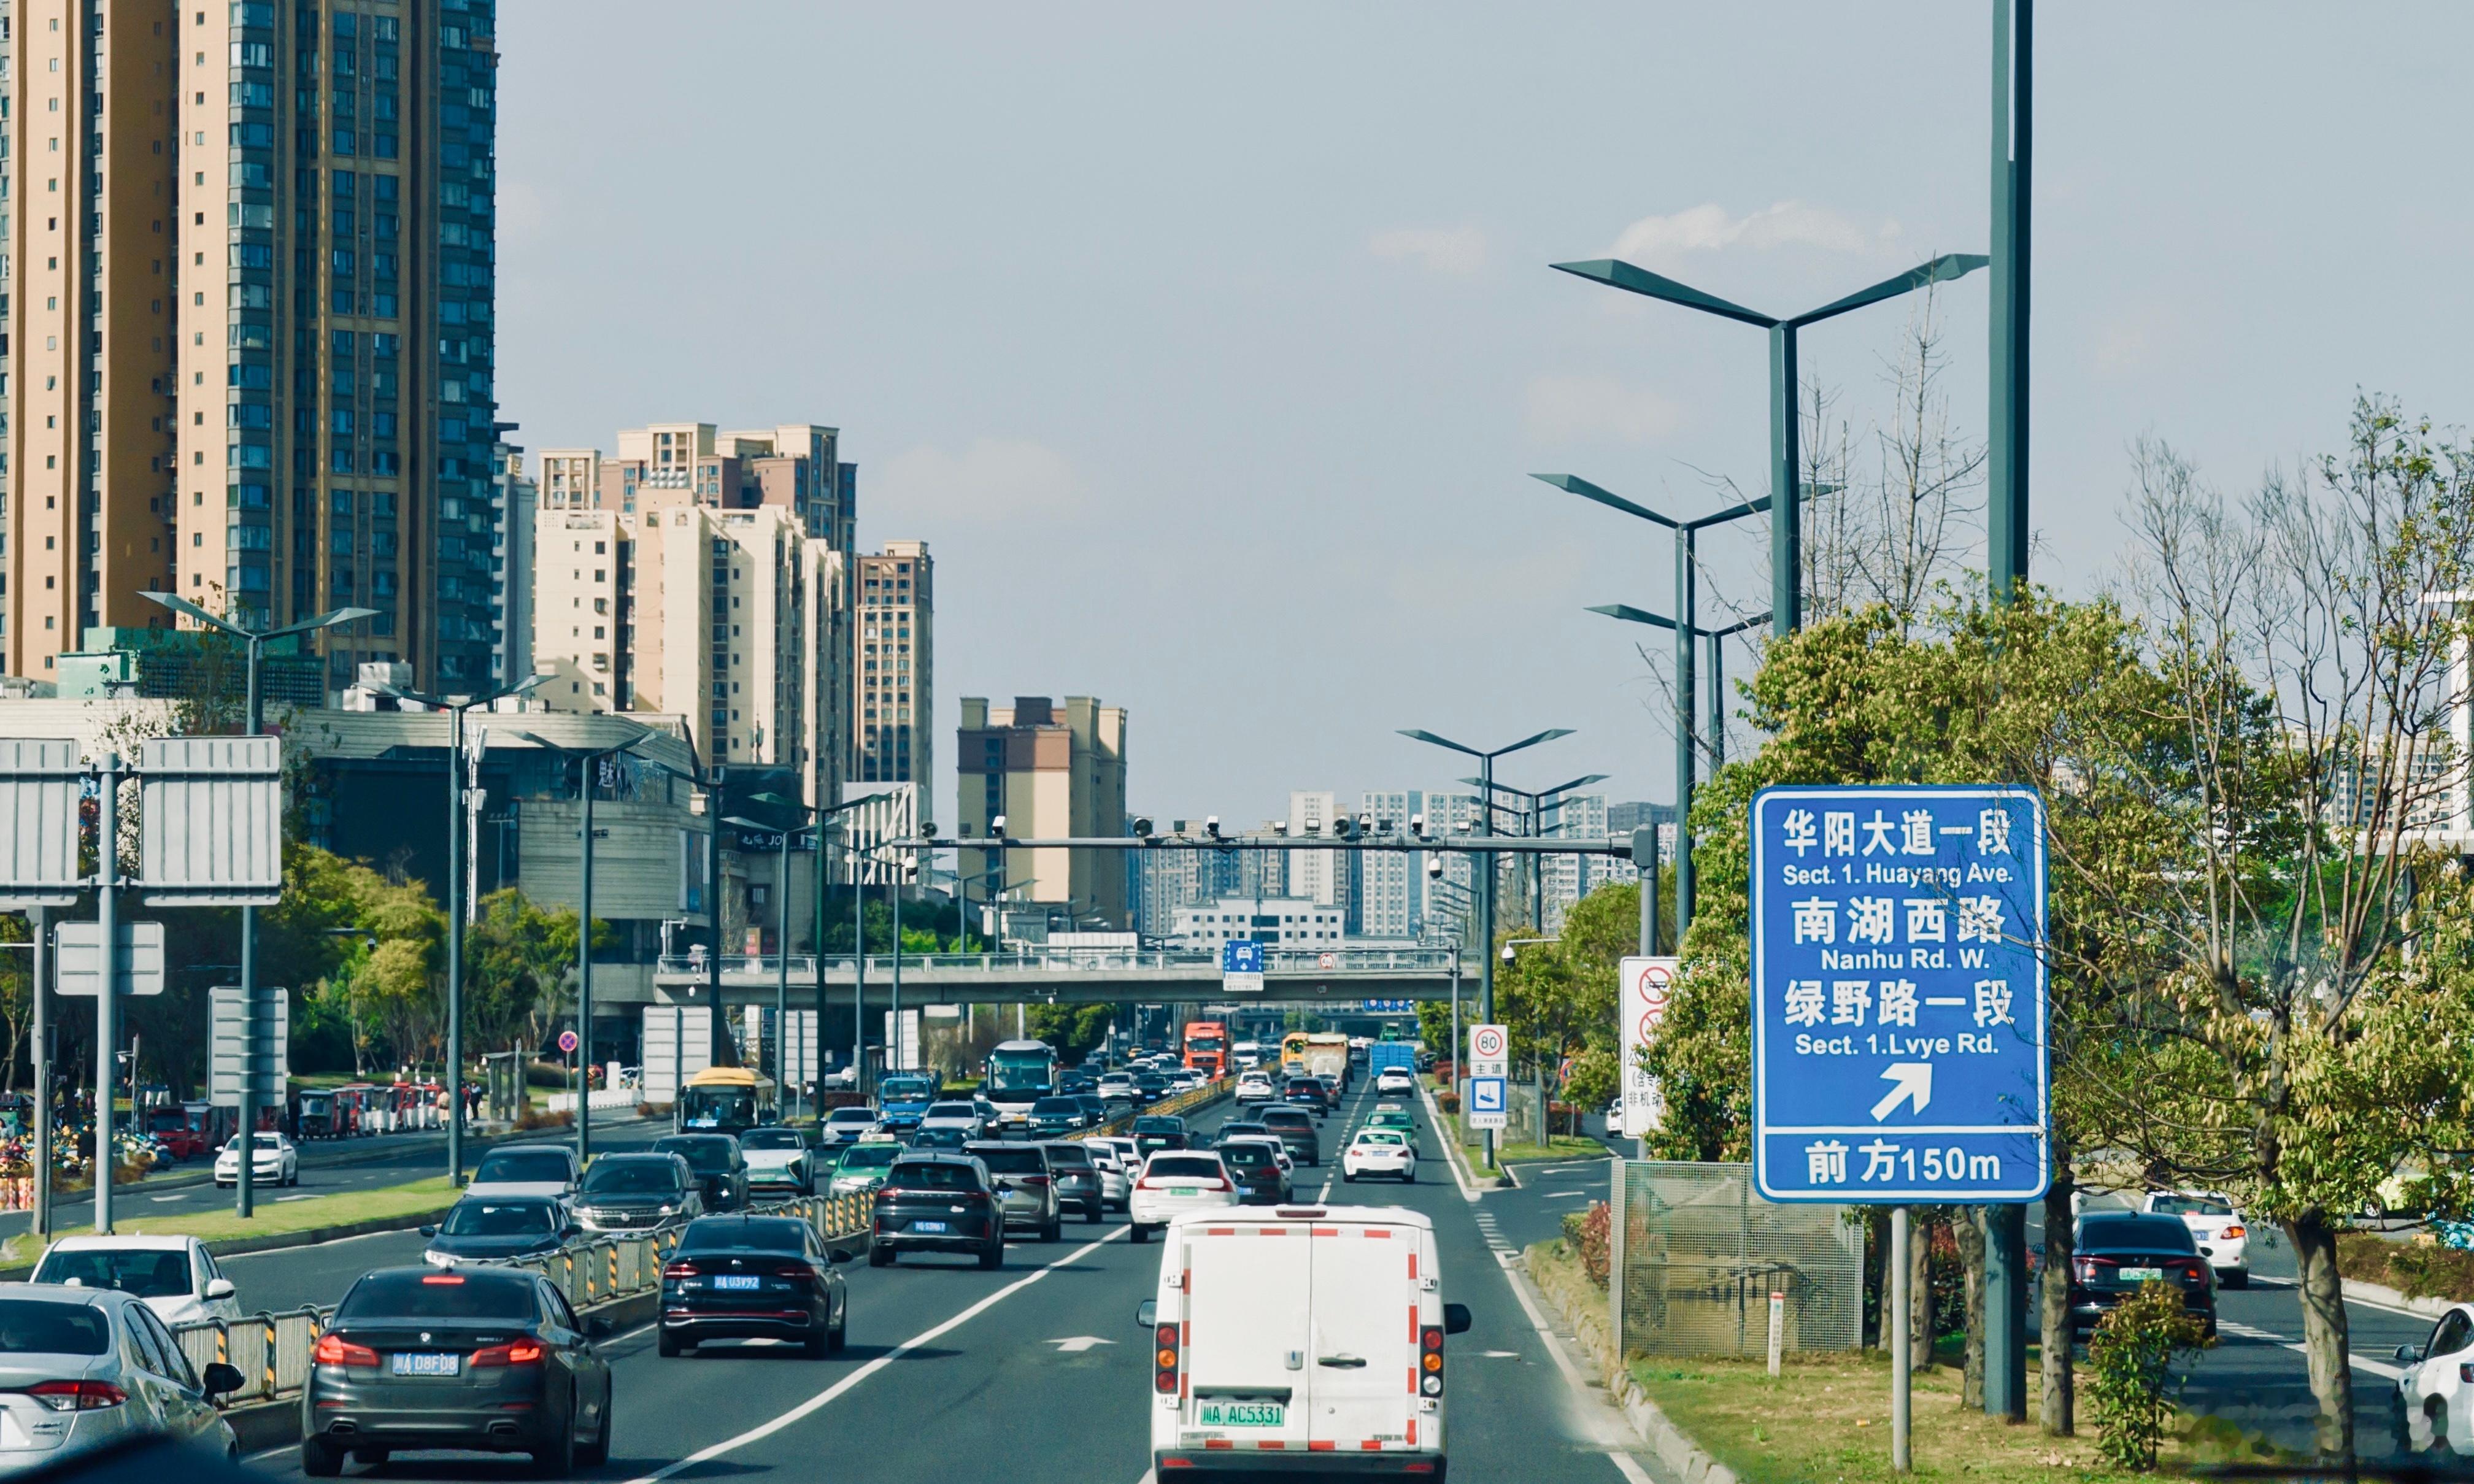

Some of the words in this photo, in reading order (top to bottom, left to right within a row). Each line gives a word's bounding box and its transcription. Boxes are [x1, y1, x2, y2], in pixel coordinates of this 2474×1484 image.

[1784, 809, 2010, 856] 华阳大道一段
[1784, 865, 1835, 885] Sect.
[1843, 864, 1860, 883] 1.
[1867, 864, 1960, 888] Huayang
[1967, 863, 2013, 883] Ave.
[1791, 895, 2003, 944] 南湖西路
[1822, 950, 1903, 969] Nanhu
[1912, 949, 1951, 969] Rd.
[1960, 949, 1989, 969] W.
[1784, 979, 2015, 1028] 绿野路一段
[1481, 1036, 1497, 1049] 80
[1796, 1034, 1858, 1055] Sect.
[1959, 1034, 1998, 1053] Rd.
[1476, 1063, 1501, 1074] 主道
[1628, 1091, 1662, 1107] 非机动
[1806, 1139, 2000, 1183] 前方150m
